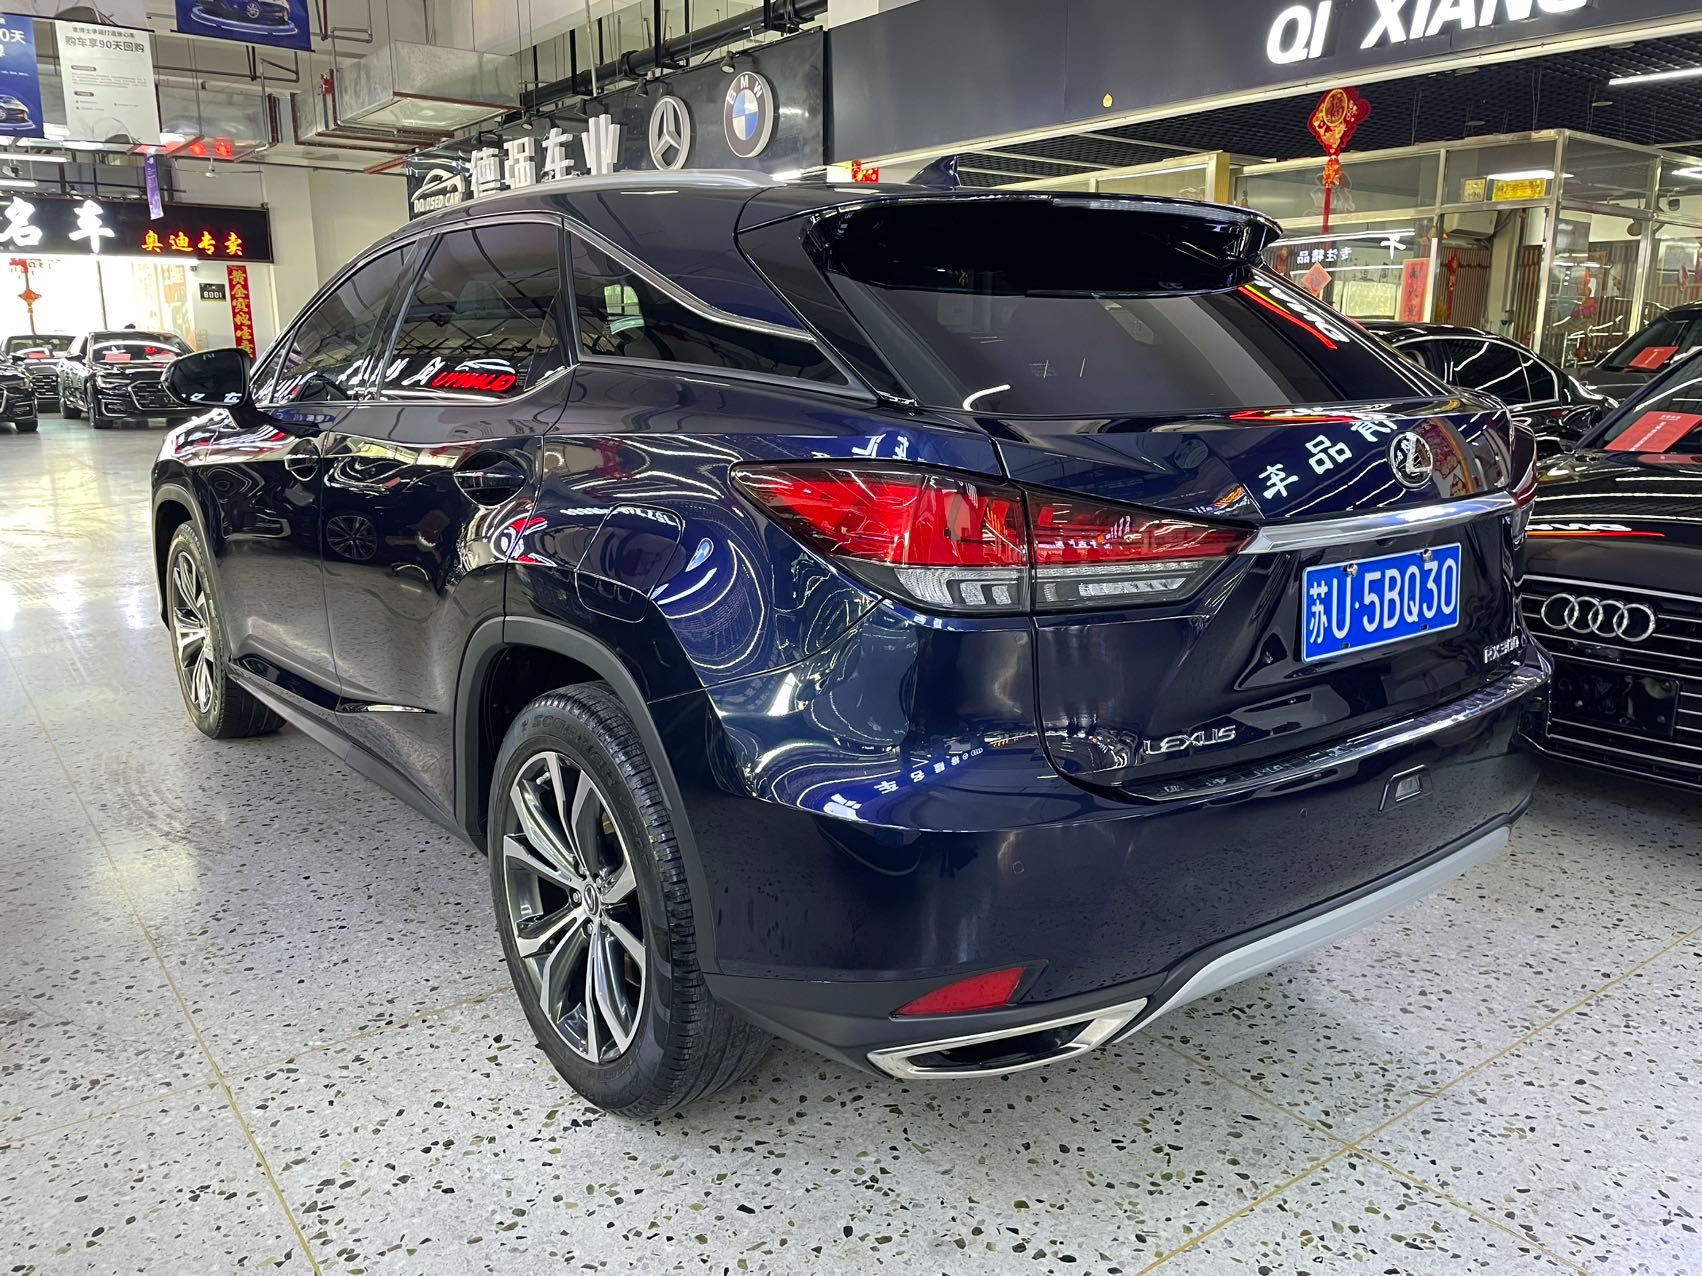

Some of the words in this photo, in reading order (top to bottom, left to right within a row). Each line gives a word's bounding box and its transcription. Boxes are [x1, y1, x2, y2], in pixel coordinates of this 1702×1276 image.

[65, 36, 145, 53] 购车享90天回购
[1266, 0, 1331, 65] QI
[1360, 0, 1587, 49] XIA
[727, 74, 763, 105] BMW
[426, 195, 443, 209] USED
[445, 192, 459, 206] CAR
[141, 229, 244, 257] 奥迪专卖
[1143, 725, 1236, 755] LEXUS
